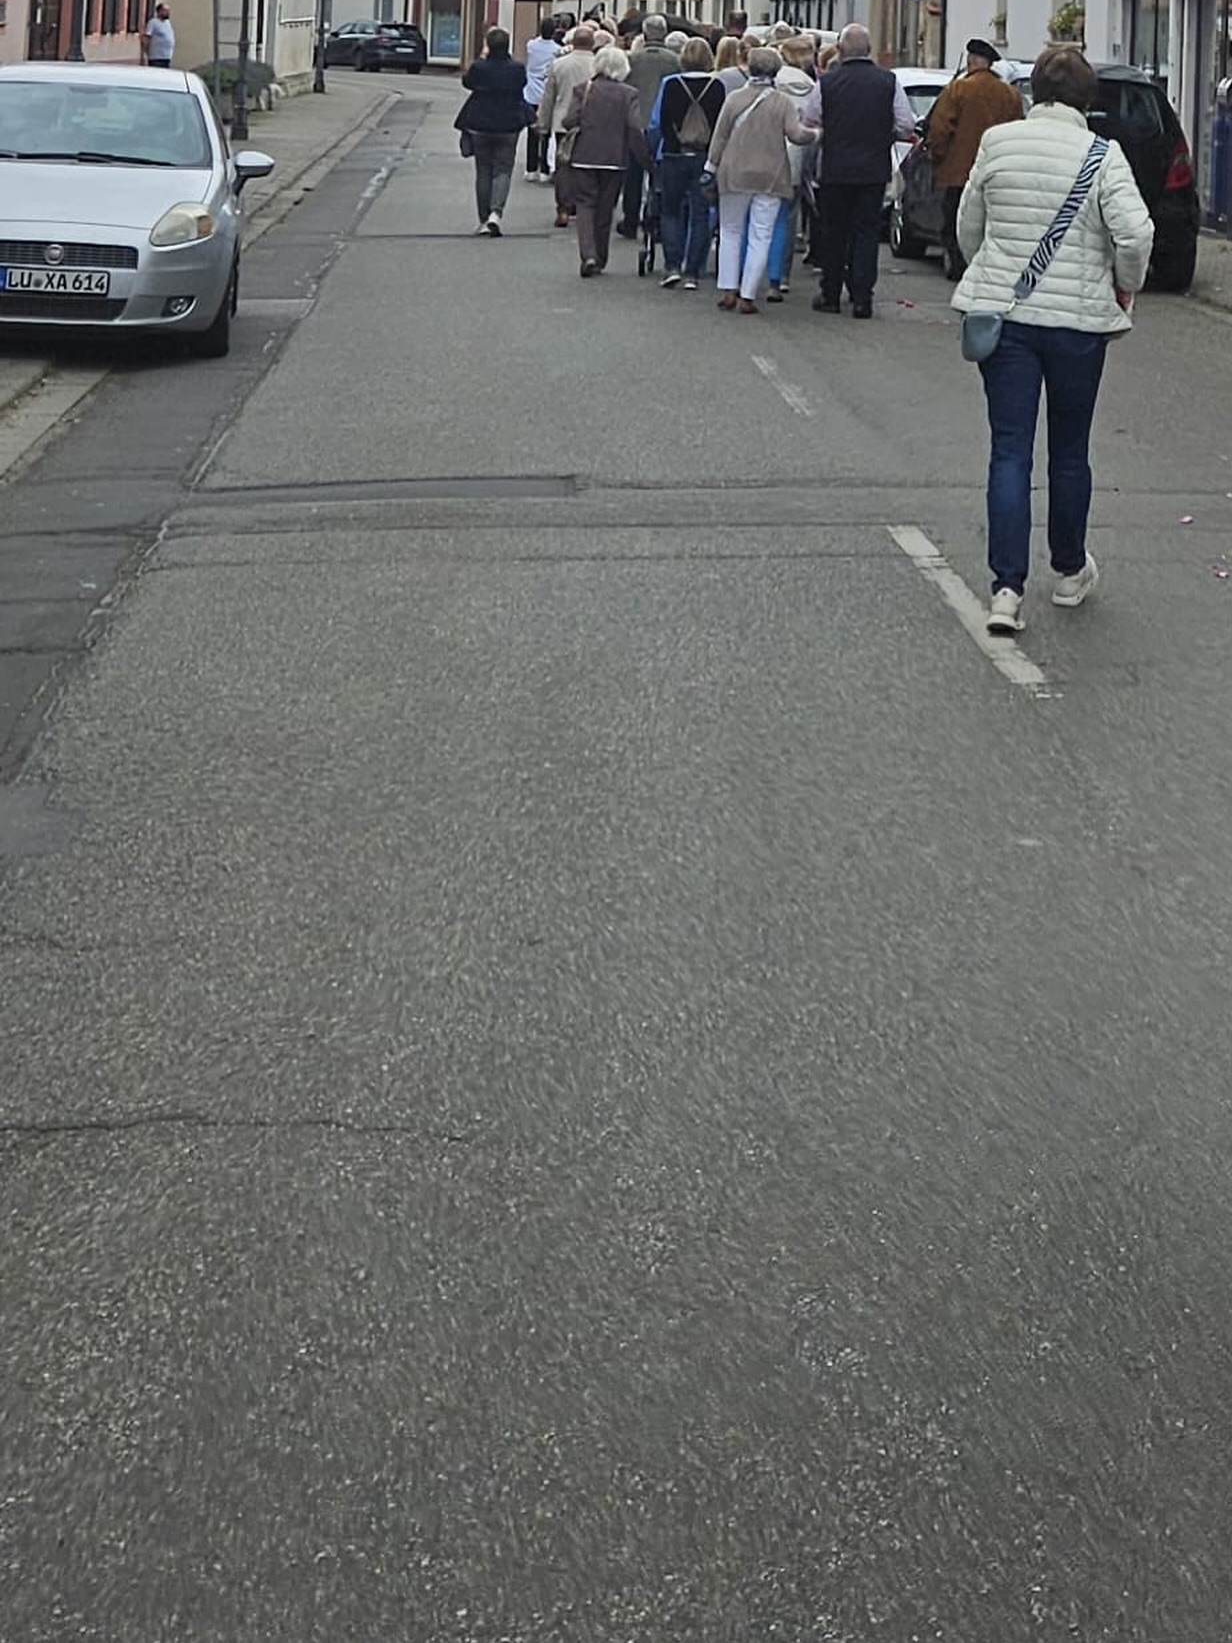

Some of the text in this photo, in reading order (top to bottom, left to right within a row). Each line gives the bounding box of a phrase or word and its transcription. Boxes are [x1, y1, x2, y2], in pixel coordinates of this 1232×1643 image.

[7, 270, 107, 292] LU XA 614
